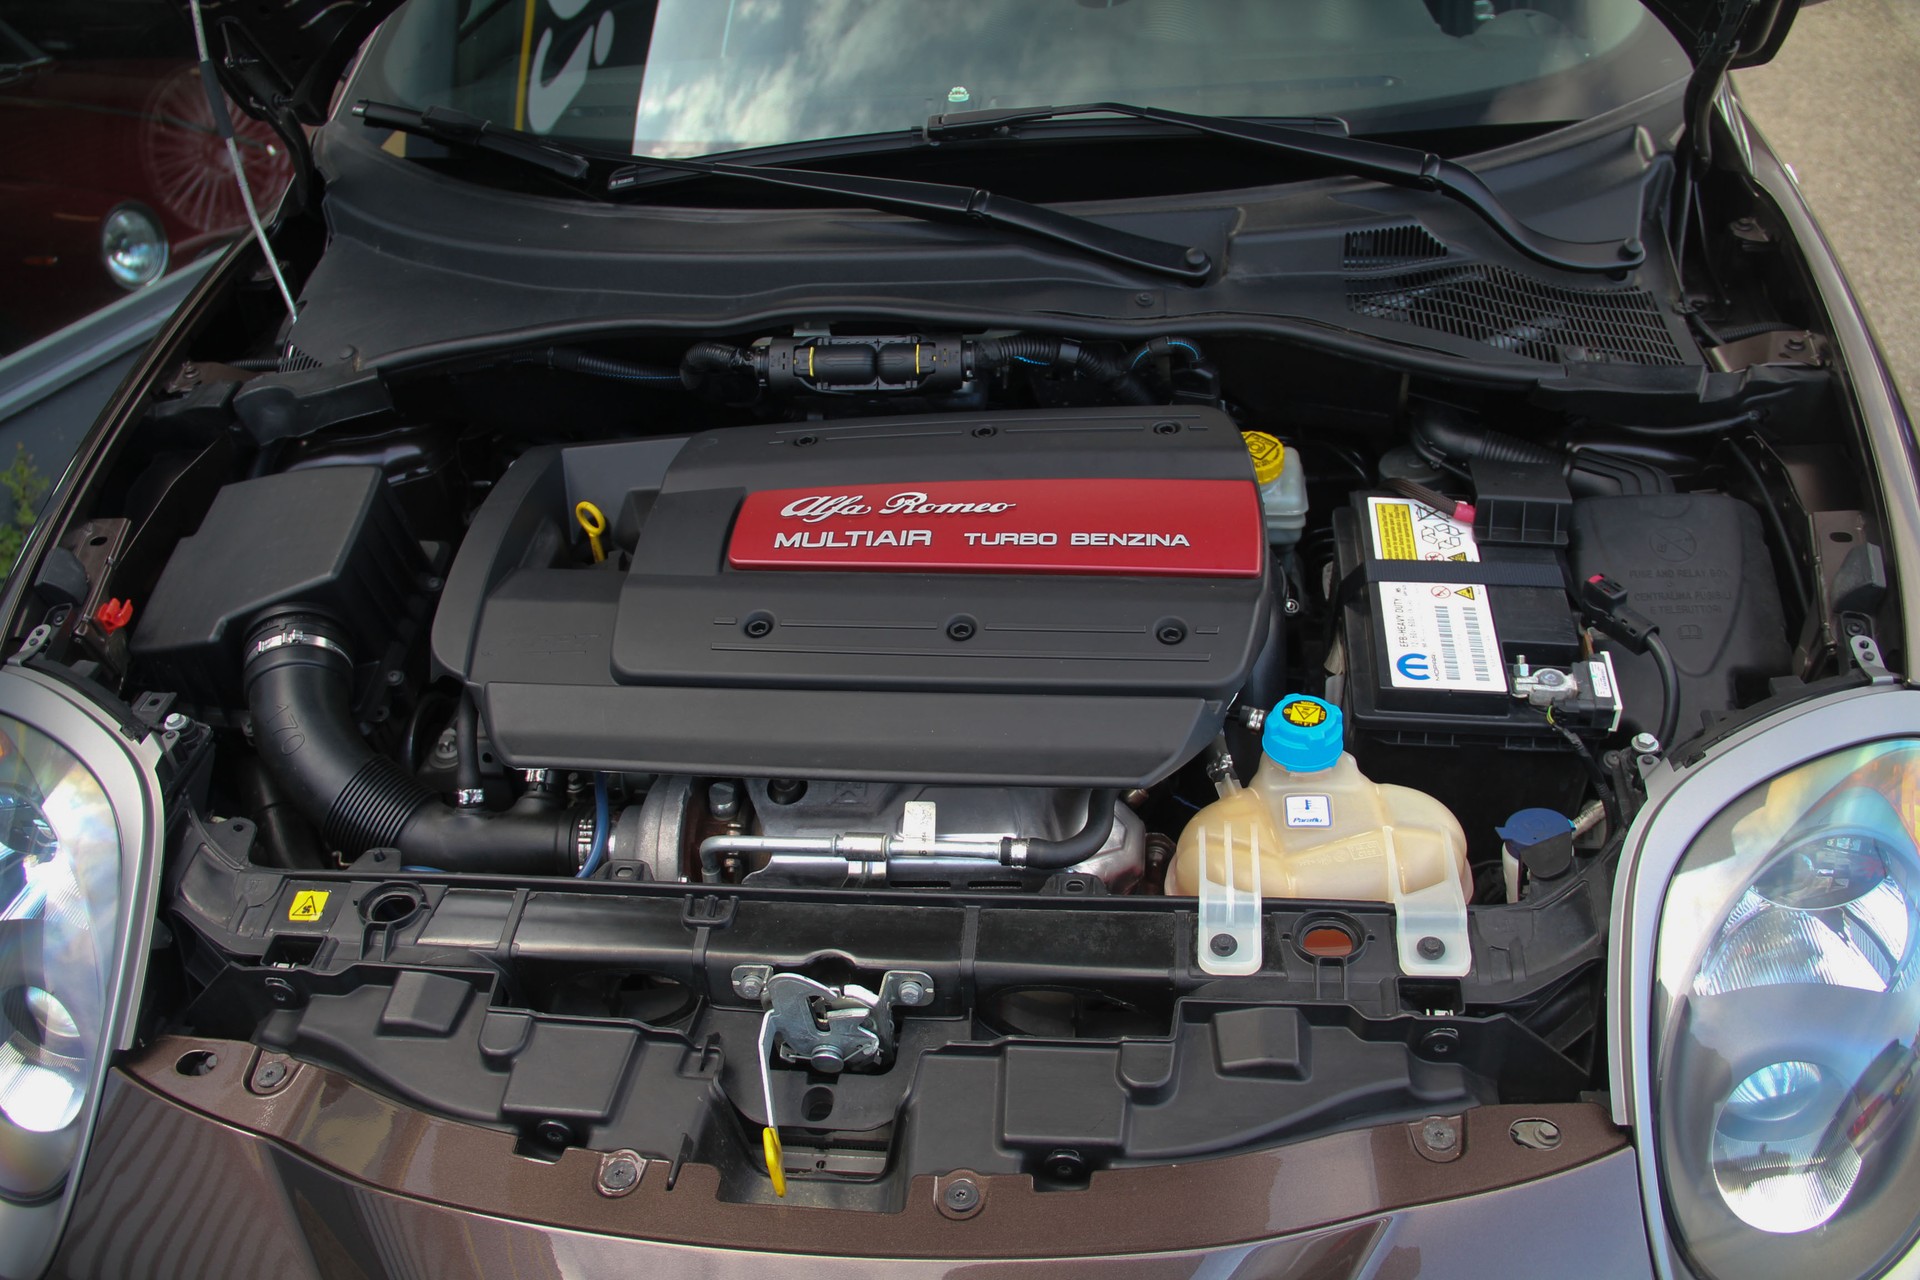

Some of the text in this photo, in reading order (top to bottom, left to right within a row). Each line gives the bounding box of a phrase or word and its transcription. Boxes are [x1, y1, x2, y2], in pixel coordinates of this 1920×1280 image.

[780, 491, 1016, 523] Alfa Romeo
[773, 529, 933, 549] MULTIAIR
[964, 532, 1191, 548] TURBO BENZINA
[266, 704, 306, 756] 170
